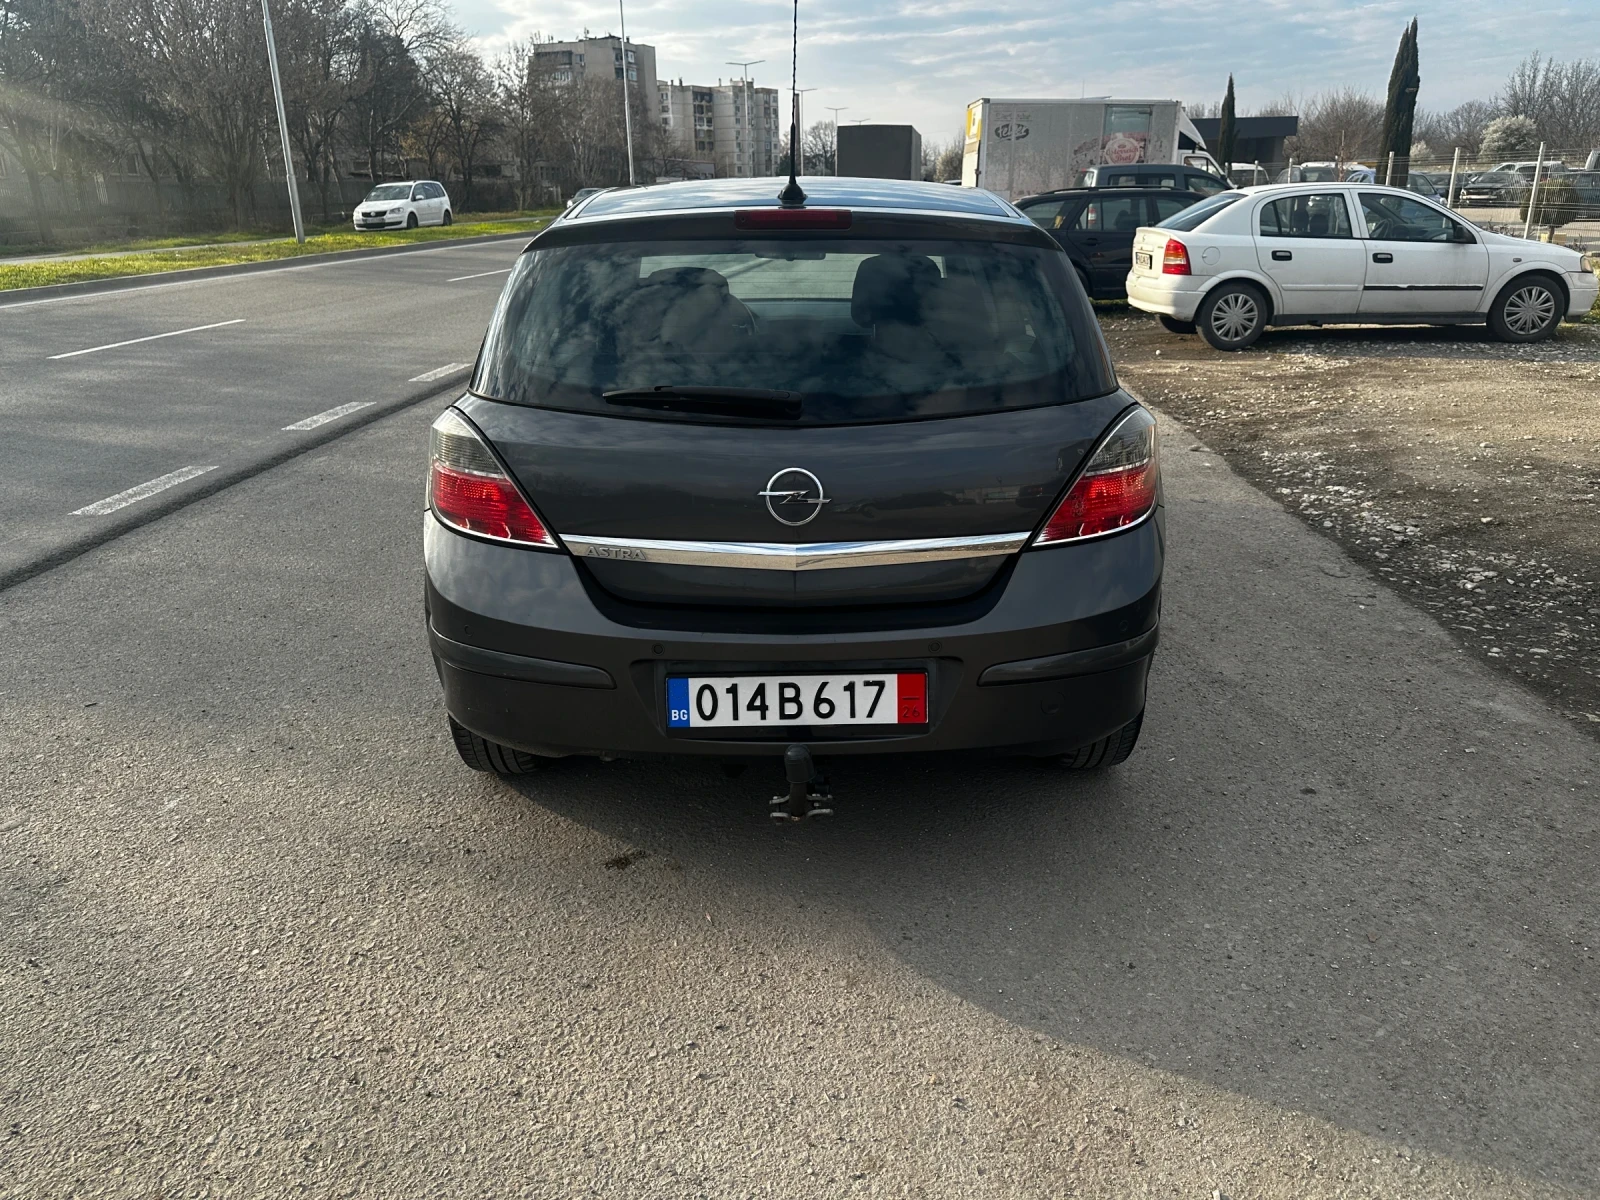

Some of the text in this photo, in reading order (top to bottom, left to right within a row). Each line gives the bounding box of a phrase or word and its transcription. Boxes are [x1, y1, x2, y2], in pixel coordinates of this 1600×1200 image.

[587, 546, 646, 560] ASTRA
[696, 680, 886, 721] 014B617
[671, 709, 688, 721] BG
[902, 704, 920, 718] 26
